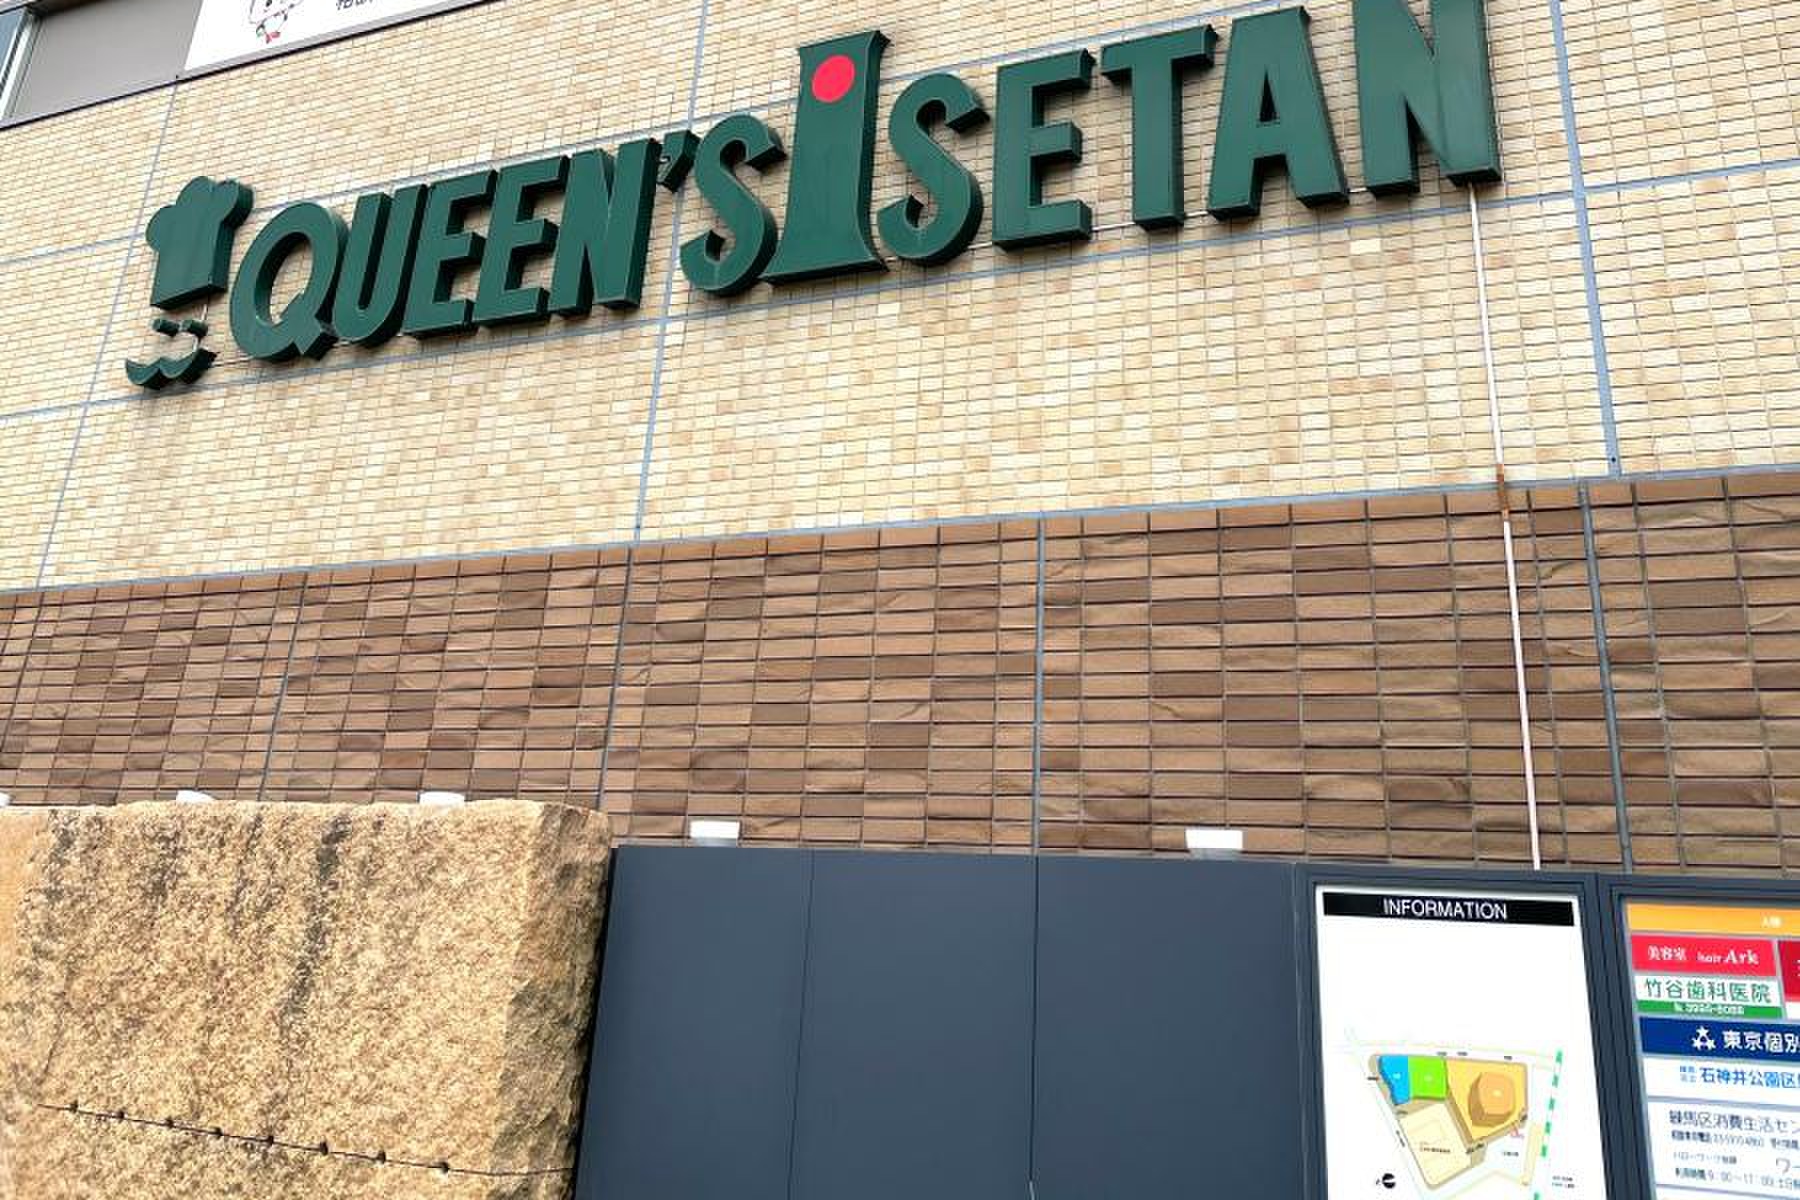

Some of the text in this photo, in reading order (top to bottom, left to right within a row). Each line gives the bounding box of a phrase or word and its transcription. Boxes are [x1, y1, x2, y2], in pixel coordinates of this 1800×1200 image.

[230, 113, 786, 361] QUEEN'S
[1383, 898, 1507, 920] INFORMATION
[1646, 978, 1772, 1003] 竹谷歯科医院
[1700, 1067, 1800, 1089] 石神井公園区
